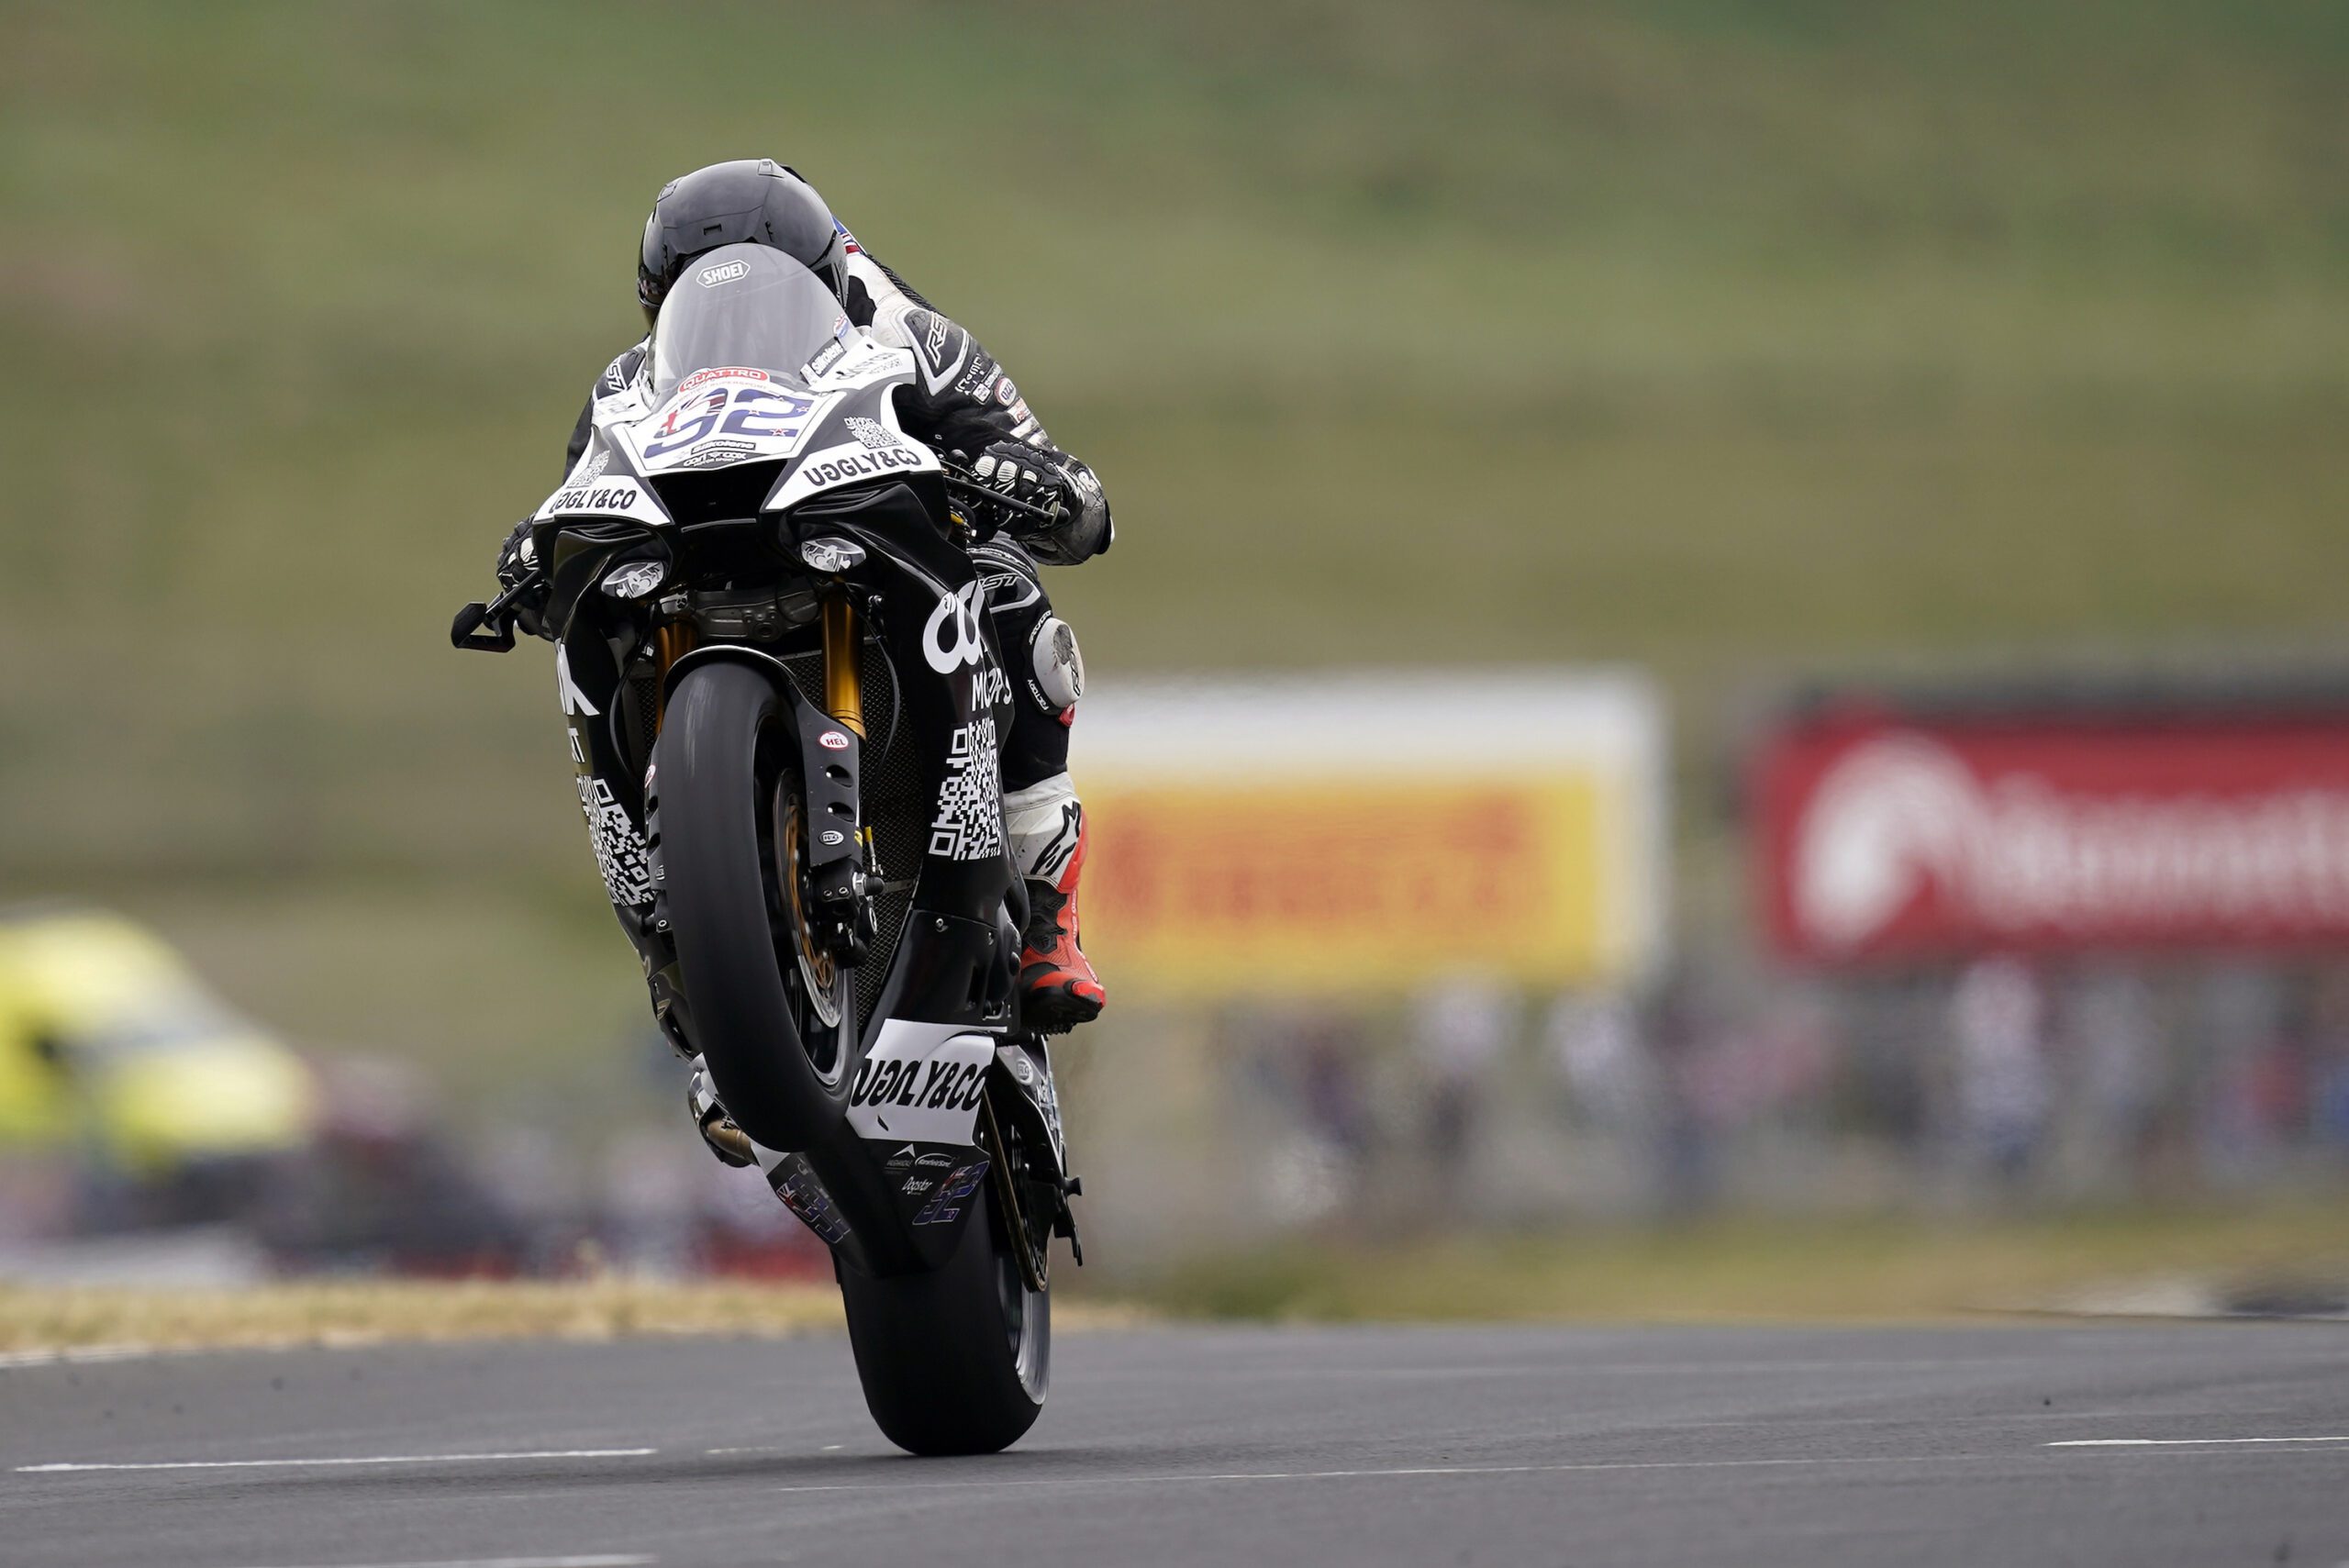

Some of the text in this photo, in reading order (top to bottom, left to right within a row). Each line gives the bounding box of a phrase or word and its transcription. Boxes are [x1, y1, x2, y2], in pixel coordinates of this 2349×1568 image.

[703, 262, 743, 284] SHOEI
[685, 369, 762, 390] QUATTRO
[643, 387, 815, 459] 92
[803, 448, 922, 487] UGGLY&CO
[826, 738, 845, 746] HEL
